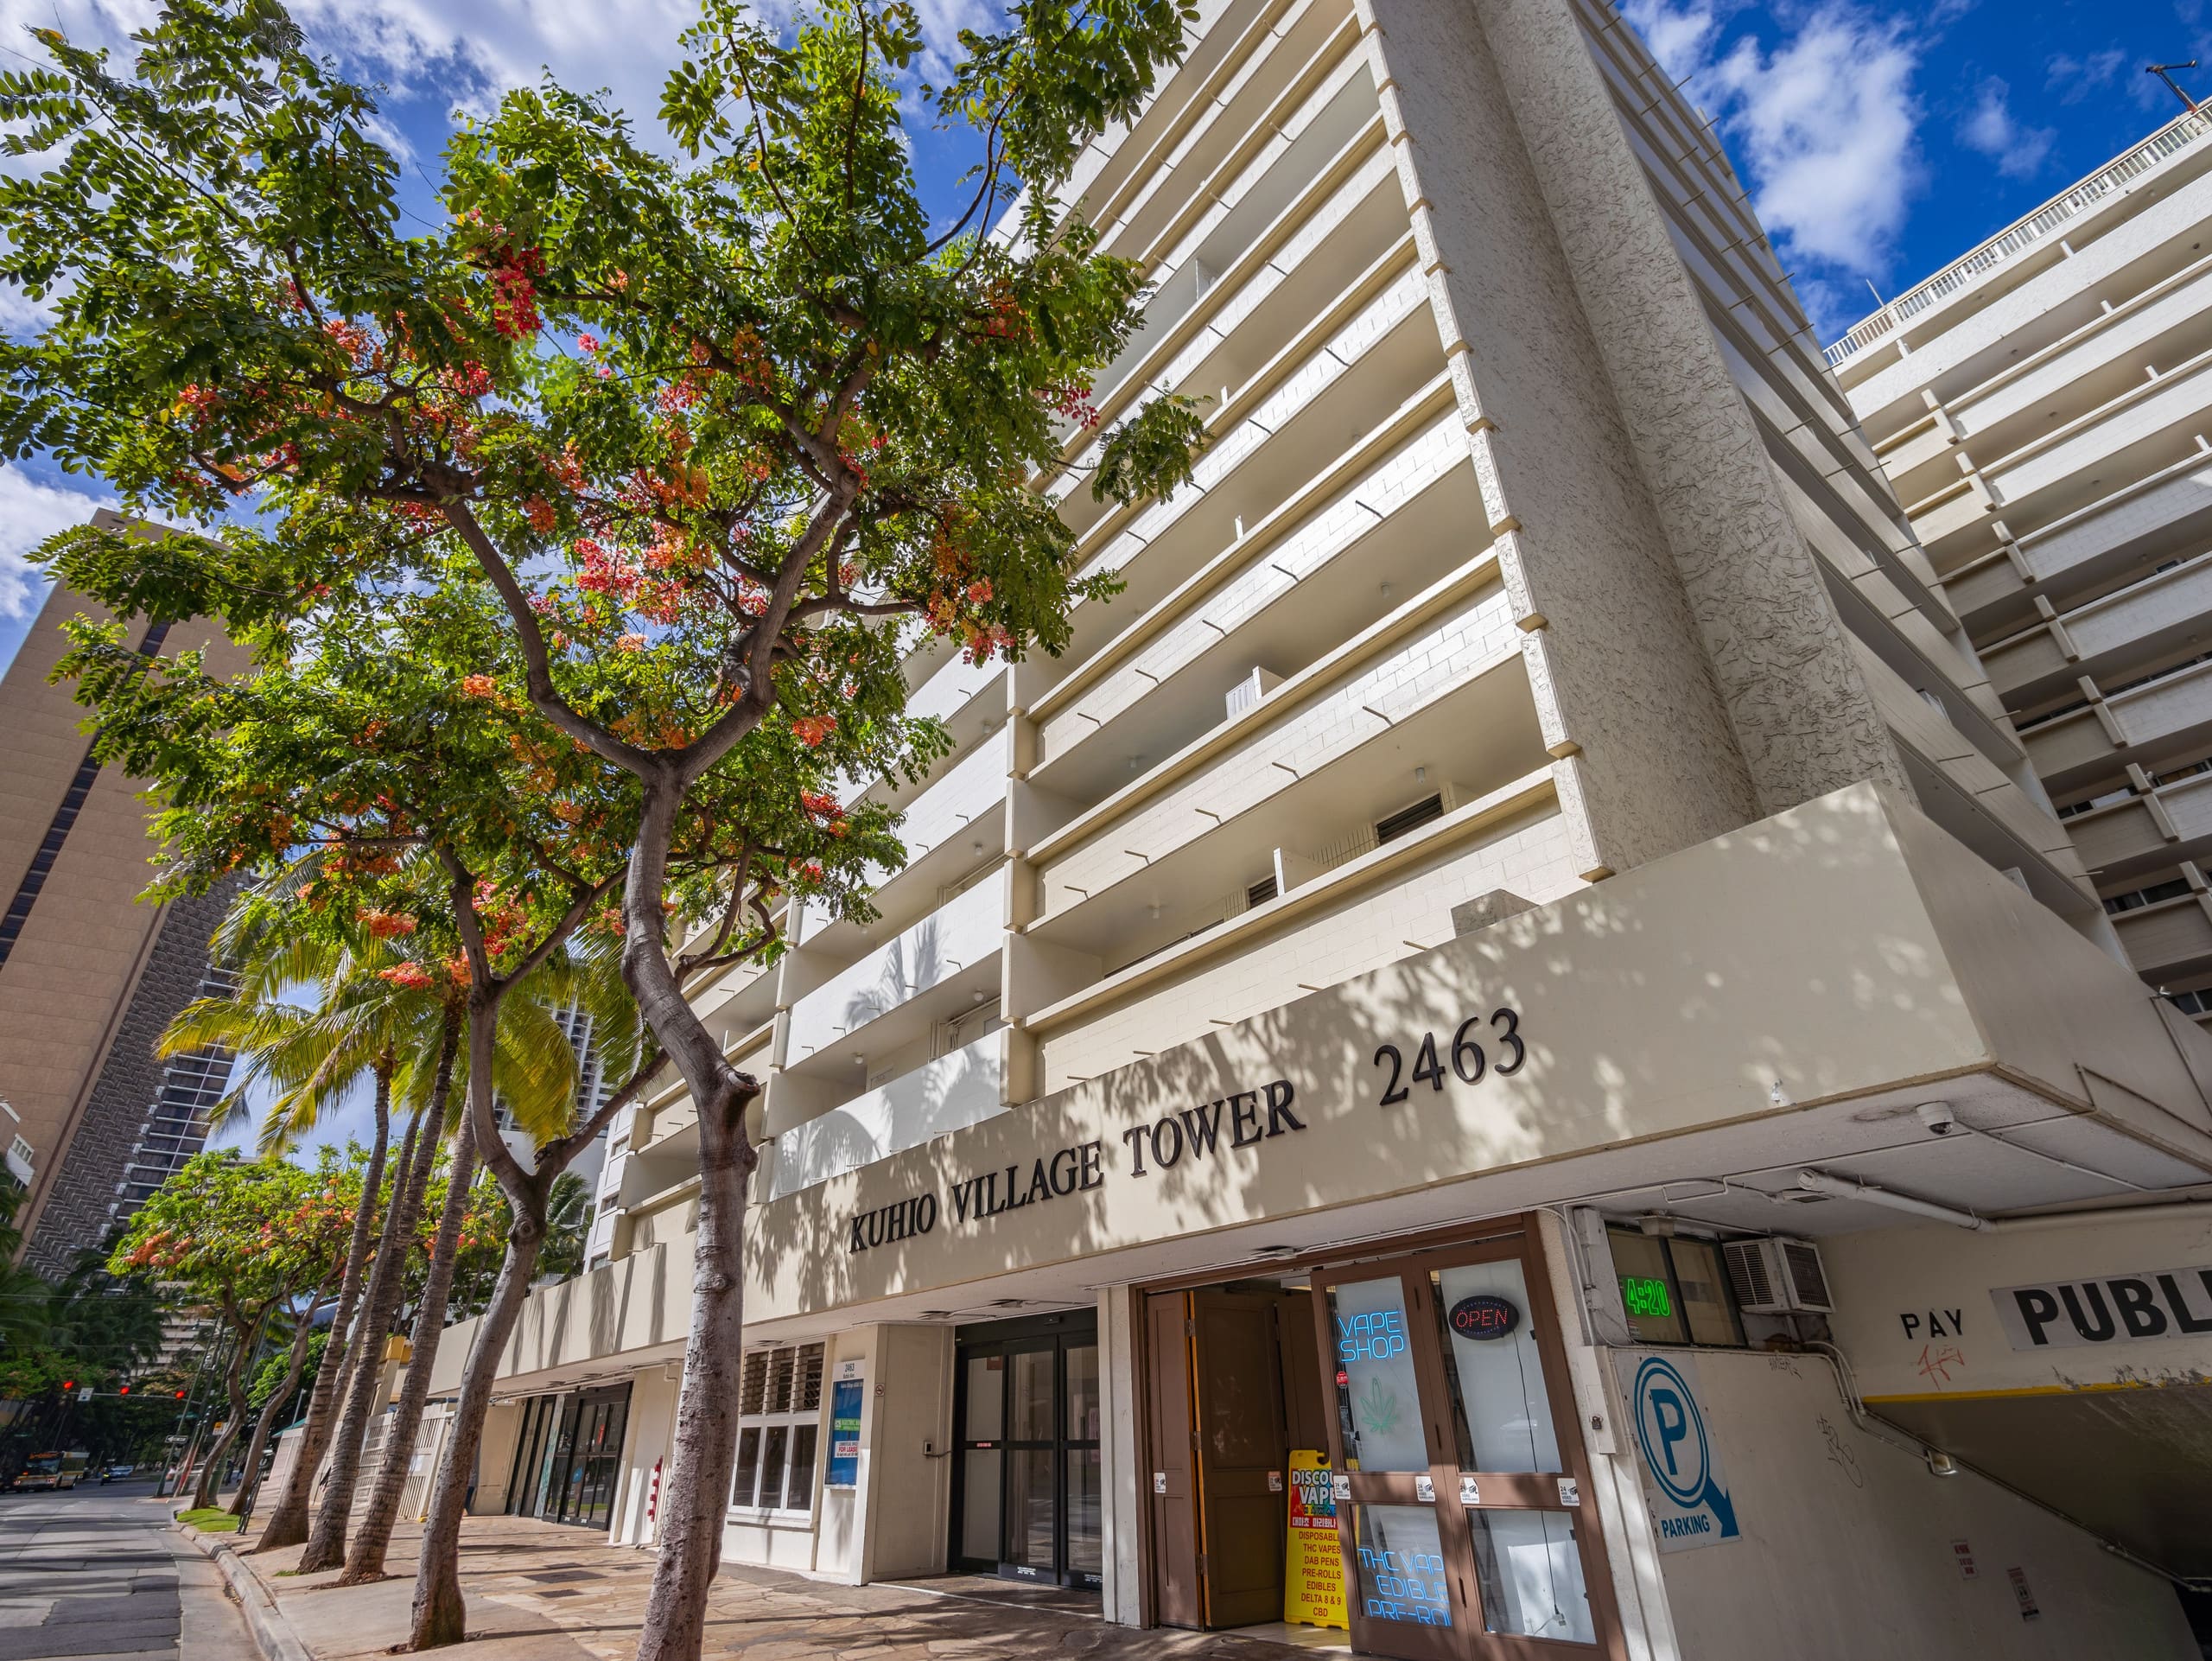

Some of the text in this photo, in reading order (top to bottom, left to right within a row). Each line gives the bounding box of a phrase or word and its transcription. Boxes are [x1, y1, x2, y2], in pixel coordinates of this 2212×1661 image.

[849, 1008, 1526, 1253] KUHIO VILLAGE TOWER 2463
[1627, 1279, 1670, 1316] 4:20
[1338, 1311, 1402, 1337] VAPE
[1456, 1308, 1508, 1328] OPEN
[1900, 1308, 1962, 1340] PAY
[1339, 1335, 1404, 1362] SHOP
[1649, 1389, 1687, 1475] P
[1661, 1514, 1710, 1538] PARKING
[1303, 1543, 1341, 1555] THC VAPES
[1357, 1548, 1400, 1571] THC
[1305, 1556, 1339, 1567] DAB PENS
[1302, 1568, 1341, 1580] PRE-ROLLS
[1306, 1581, 1336, 1592] EDIBLES
[1301, 1593, 1342, 1606] DELTA 8 & 9
[1313, 1607, 1328, 1617] CBD
